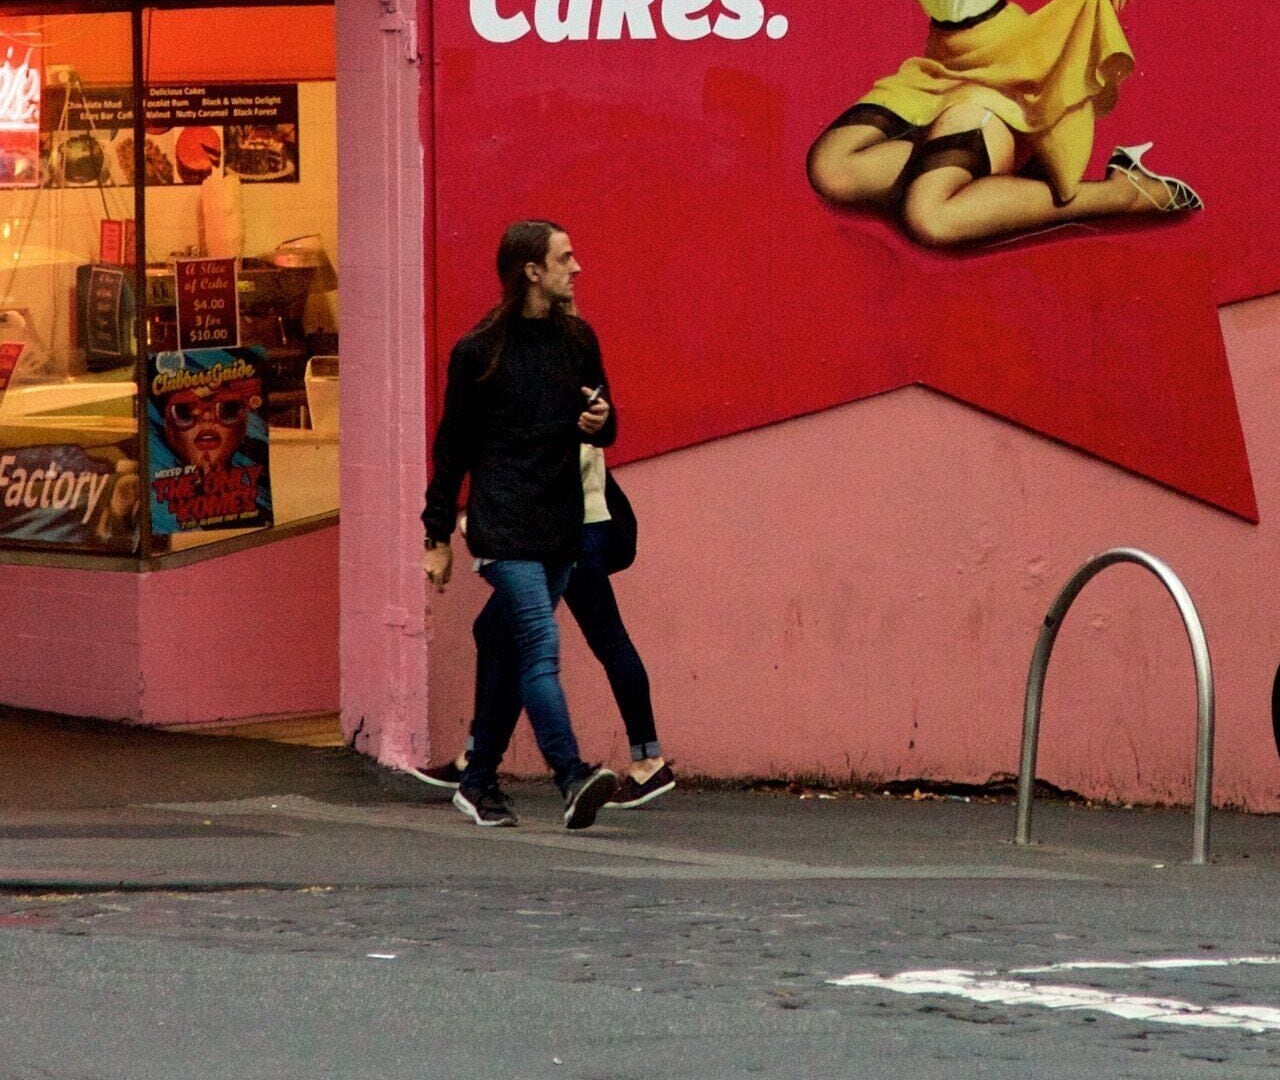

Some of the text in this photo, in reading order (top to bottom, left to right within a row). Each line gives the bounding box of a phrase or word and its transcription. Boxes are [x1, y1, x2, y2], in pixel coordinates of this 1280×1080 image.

[149, 88, 182, 96] Delicious
[175, 110, 197, 120] Nutty
[233, 108, 278, 117] Black Forest
[193, 298, 225, 311] $4.00
[190, 329, 228, 342] $10.00
